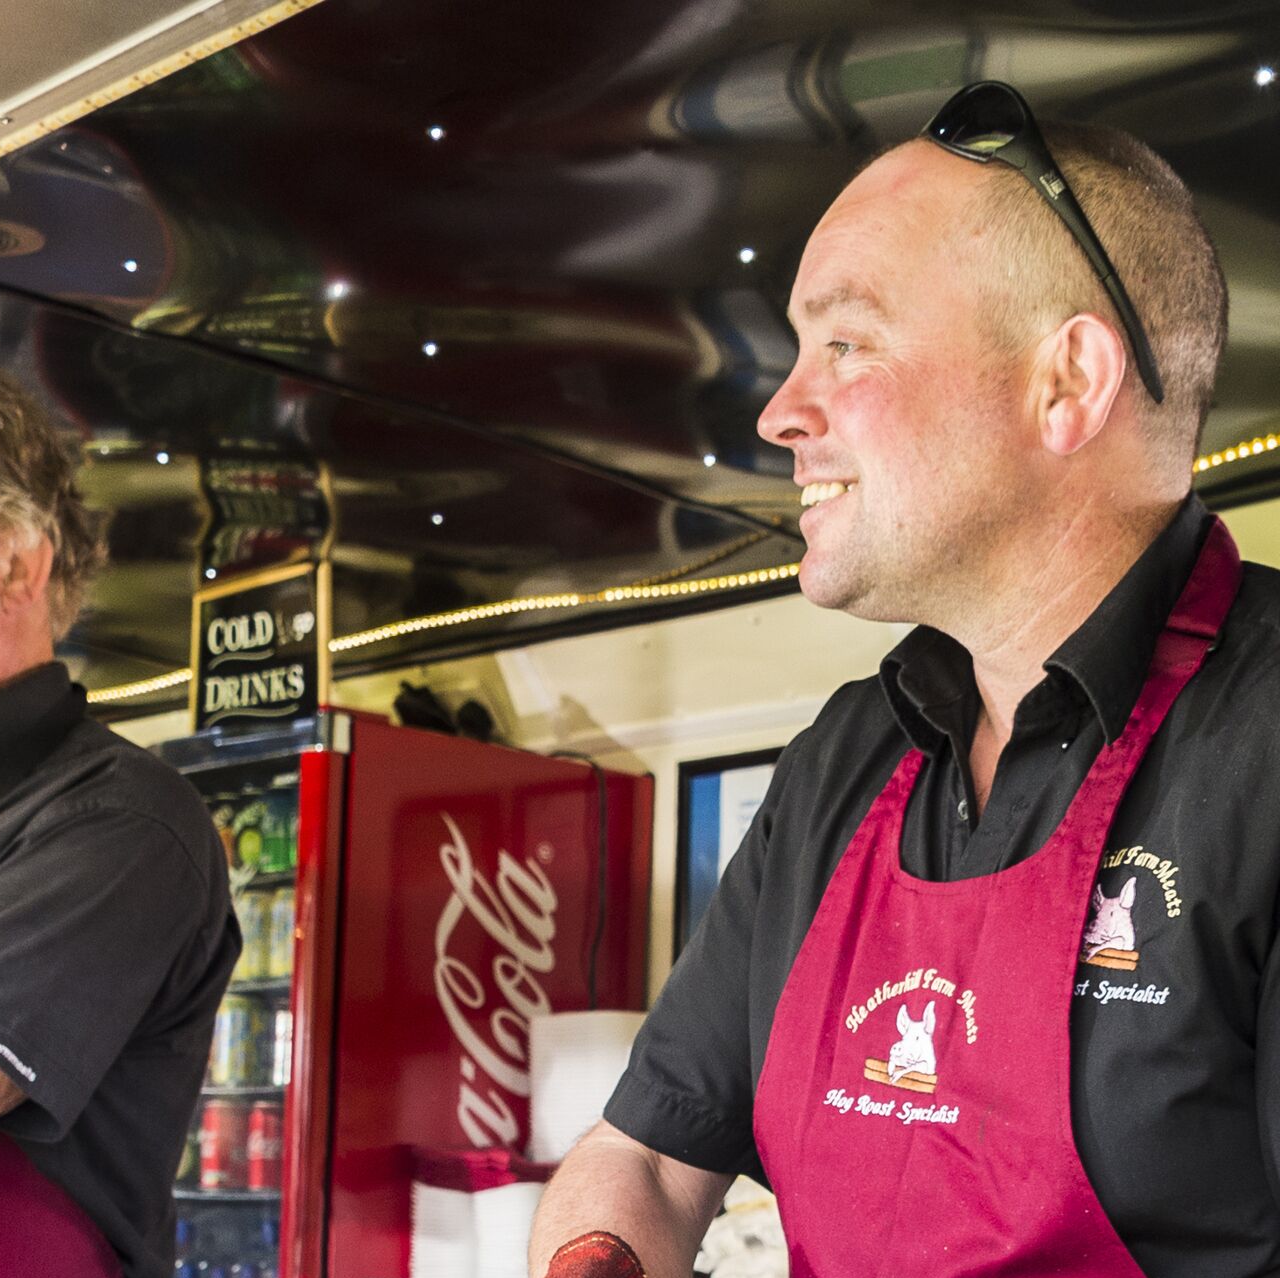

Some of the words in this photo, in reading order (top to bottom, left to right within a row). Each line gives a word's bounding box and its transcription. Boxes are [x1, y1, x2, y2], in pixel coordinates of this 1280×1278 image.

[207, 611, 274, 655] COLD
[204, 664, 306, 713] DRINKS
[1123, 845, 1160, 870] Farm
[1153, 858, 1183, 918] Meats
[922, 968, 957, 998] Farm
[1092, 979, 1171, 1005] Specialist
[823, 1088, 855, 1114] Hog
[854, 1094, 896, 1117] Roast
